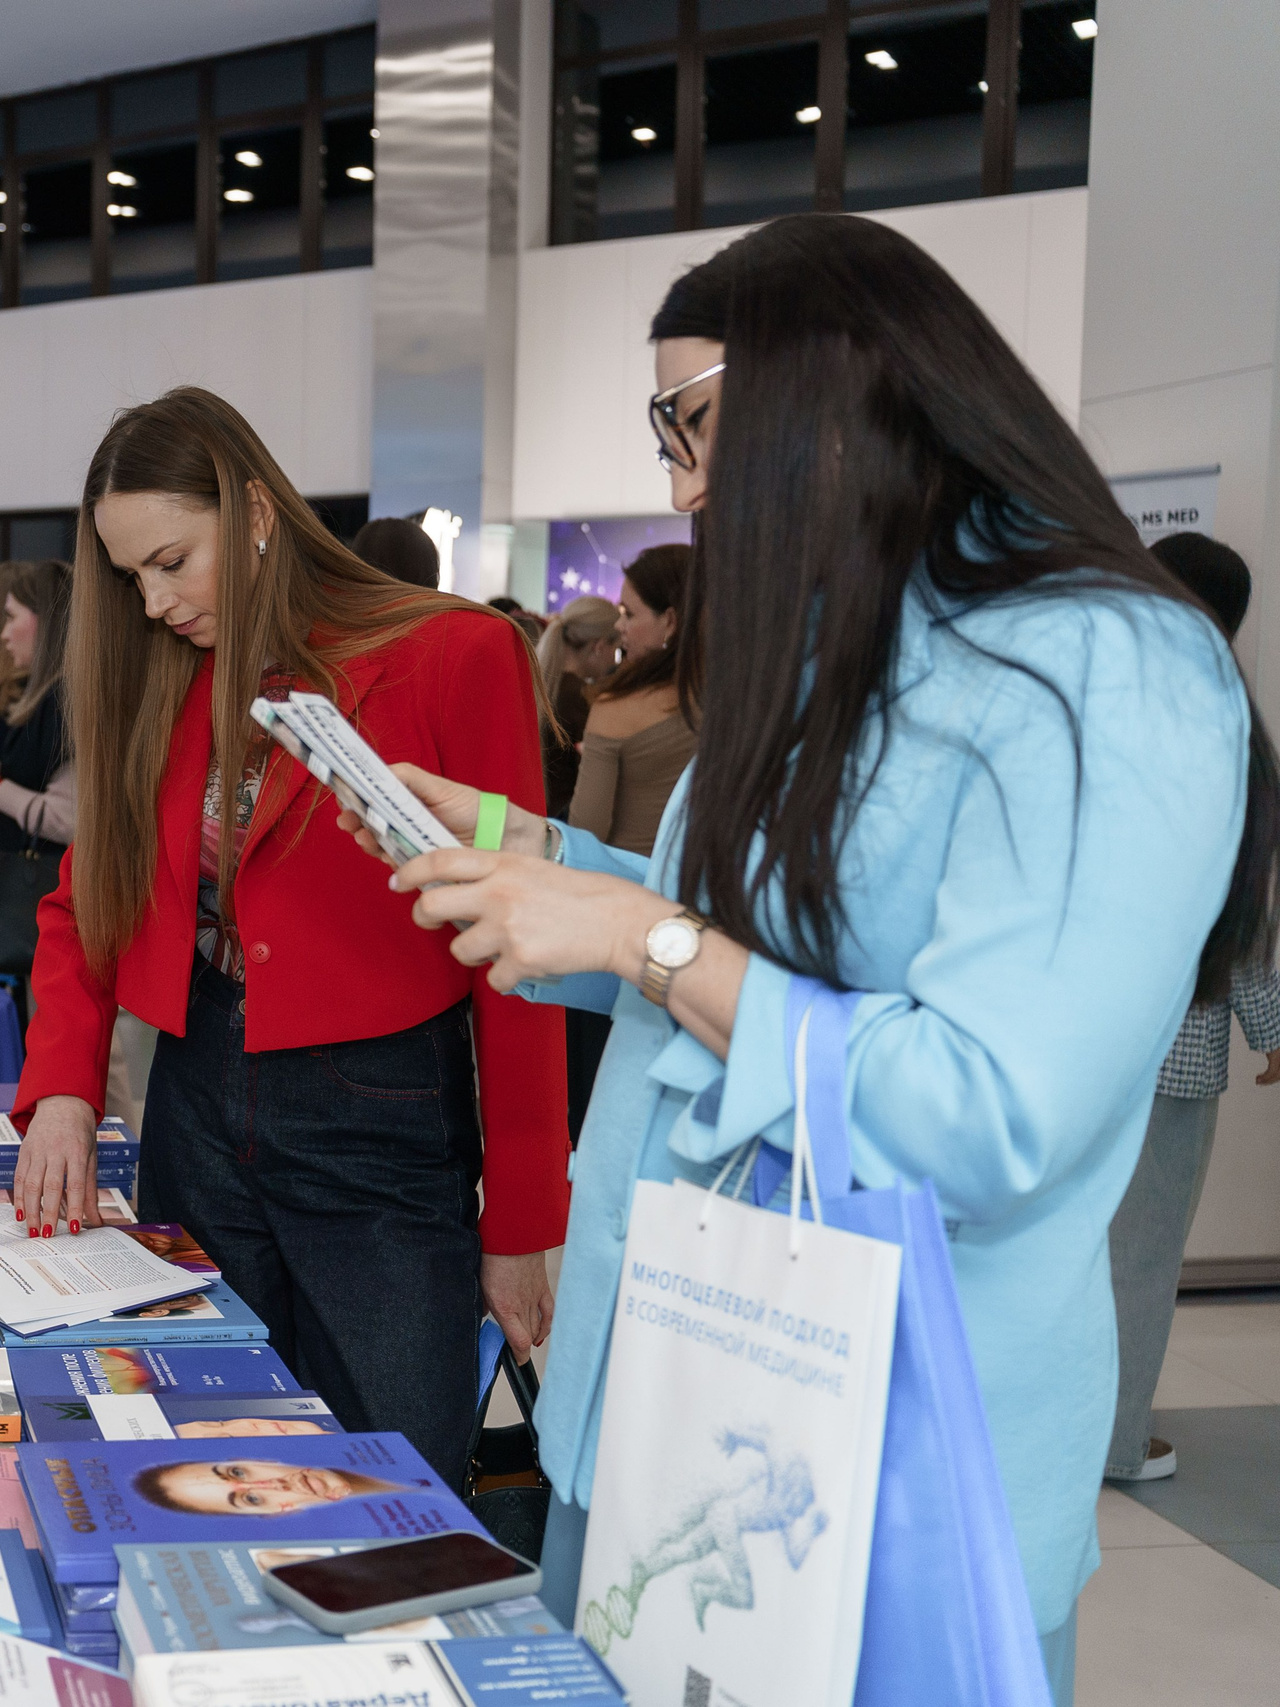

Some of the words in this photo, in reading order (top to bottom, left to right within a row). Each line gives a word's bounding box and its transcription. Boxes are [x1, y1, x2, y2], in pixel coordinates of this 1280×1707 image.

[1167, 508, 1199, 524] MED
[630, 1261, 767, 1324] МНОГОЦЕЛЕВОЙ
[769, 1307, 851, 1364] ПОДХОД
[61, 1353, 81, 1371] после
[82, 1349, 111, 1378] филлеров
[625, 1294, 636, 1316] В
[636, 1299, 747, 1358] СОВРЕМЕННОЙ
[748, 1340, 846, 1398] МЕДИЦИНЕ
[44, 1458, 97, 1533] ОПАСНЫЕ
